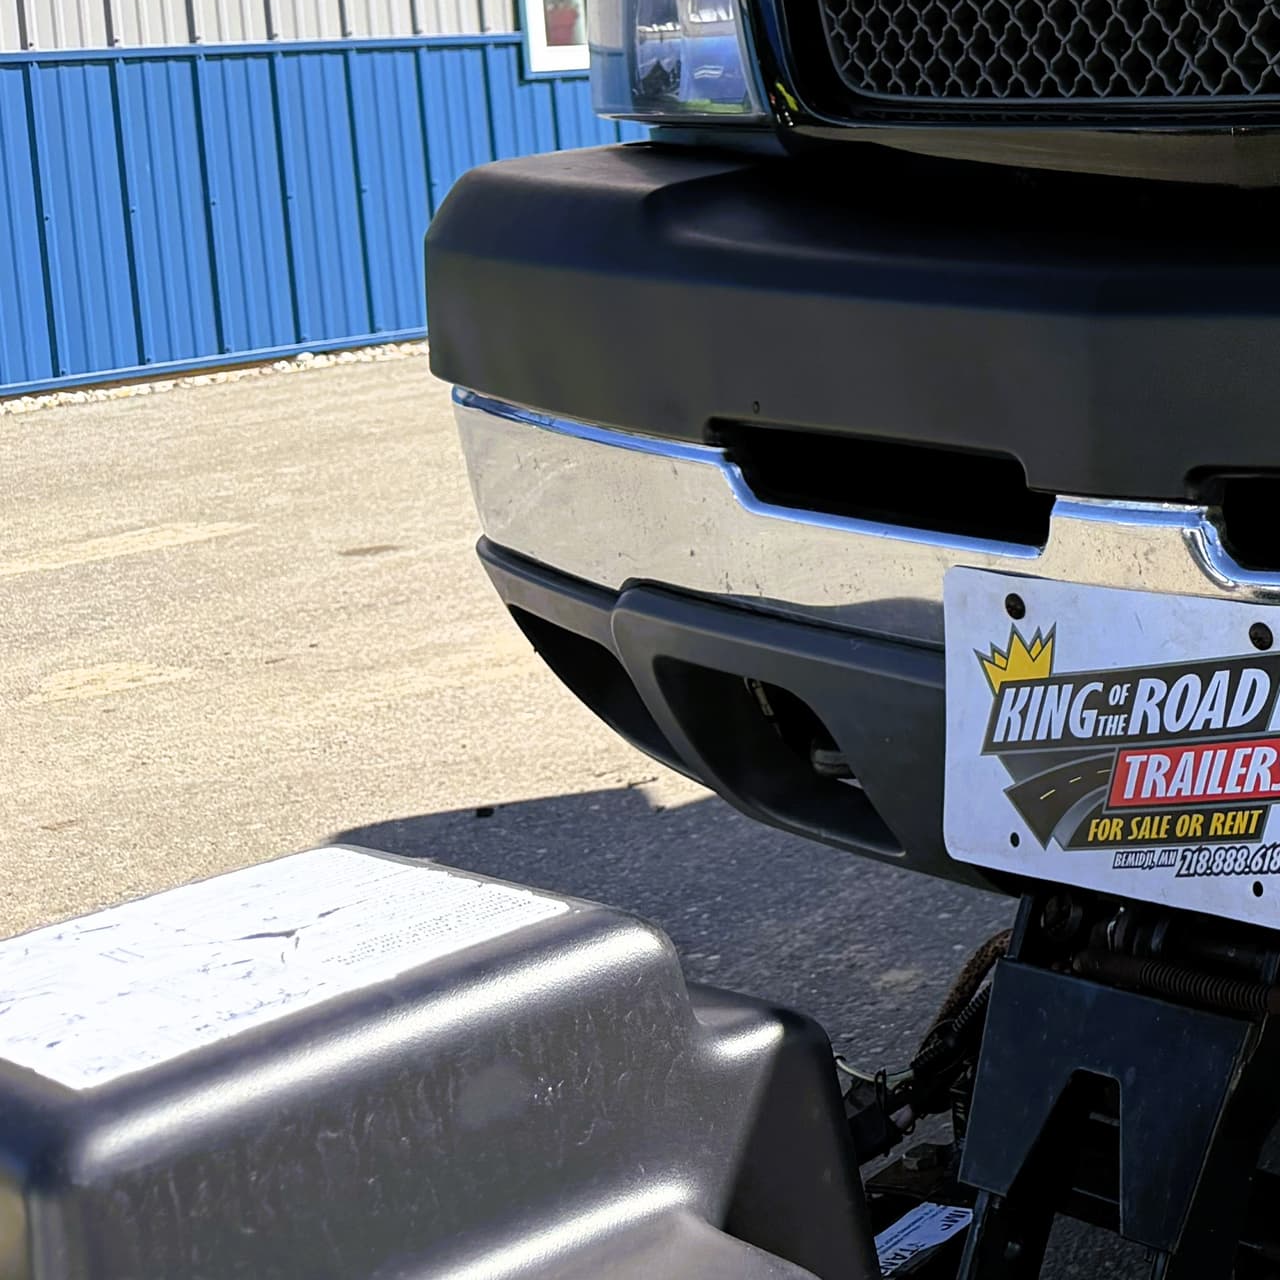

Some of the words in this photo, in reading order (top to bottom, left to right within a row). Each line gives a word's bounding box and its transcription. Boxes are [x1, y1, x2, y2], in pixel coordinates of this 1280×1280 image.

[1108, 683, 1131, 707] OF
[1127, 667, 1271, 736] ROAD
[993, 681, 1104, 743] KING
[1097, 714, 1128, 737] THE
[1087, 817, 1125, 842] FOR
[1127, 814, 1172, 840] SALE
[1175, 812, 1205, 838] OR
[1208, 808, 1264, 837] RENT
[1113, 850, 1156, 870] BEMIDJI,
[1156, 849, 1179, 868] MN
